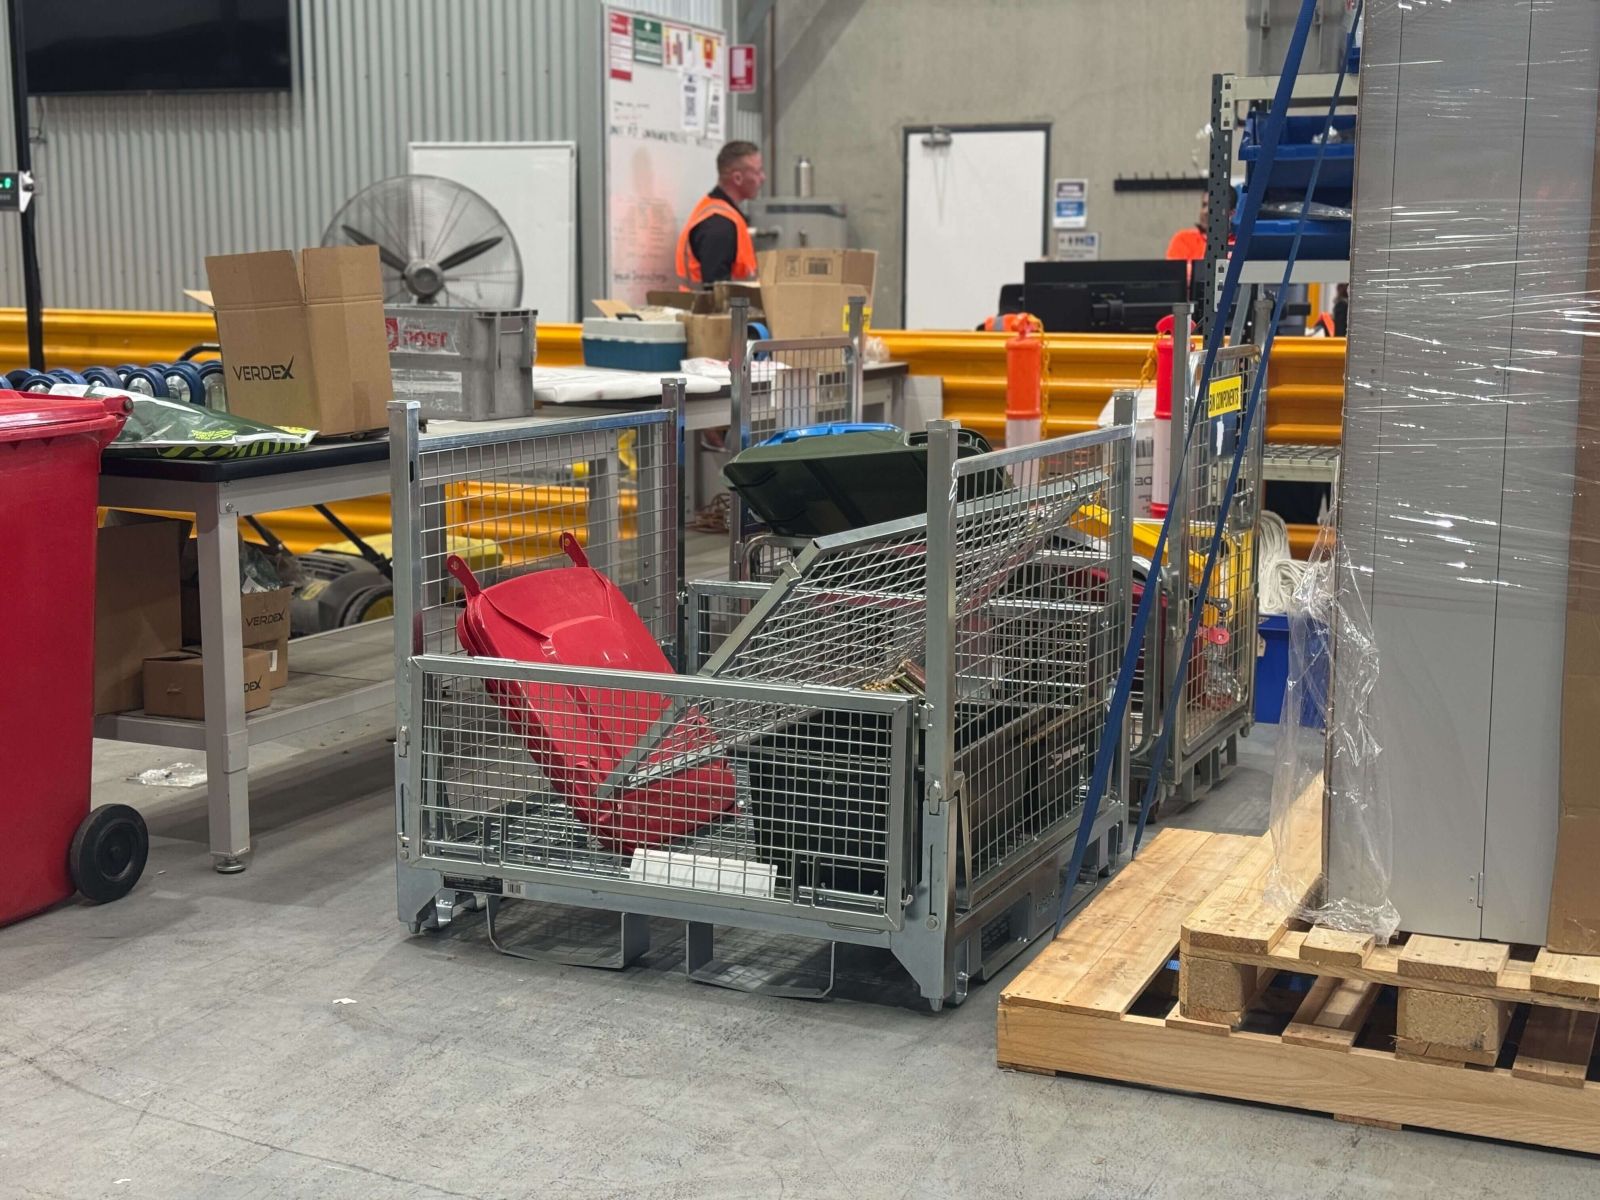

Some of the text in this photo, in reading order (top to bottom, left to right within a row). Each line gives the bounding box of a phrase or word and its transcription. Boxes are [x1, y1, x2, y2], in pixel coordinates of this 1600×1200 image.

[403, 331, 448, 347] POST
[233, 355, 295, 380] VERDEX
[1216, 387, 1239, 409] COMPONENTS
[246, 609, 285, 627] VERDEX
[244, 676, 262, 693] DEX
